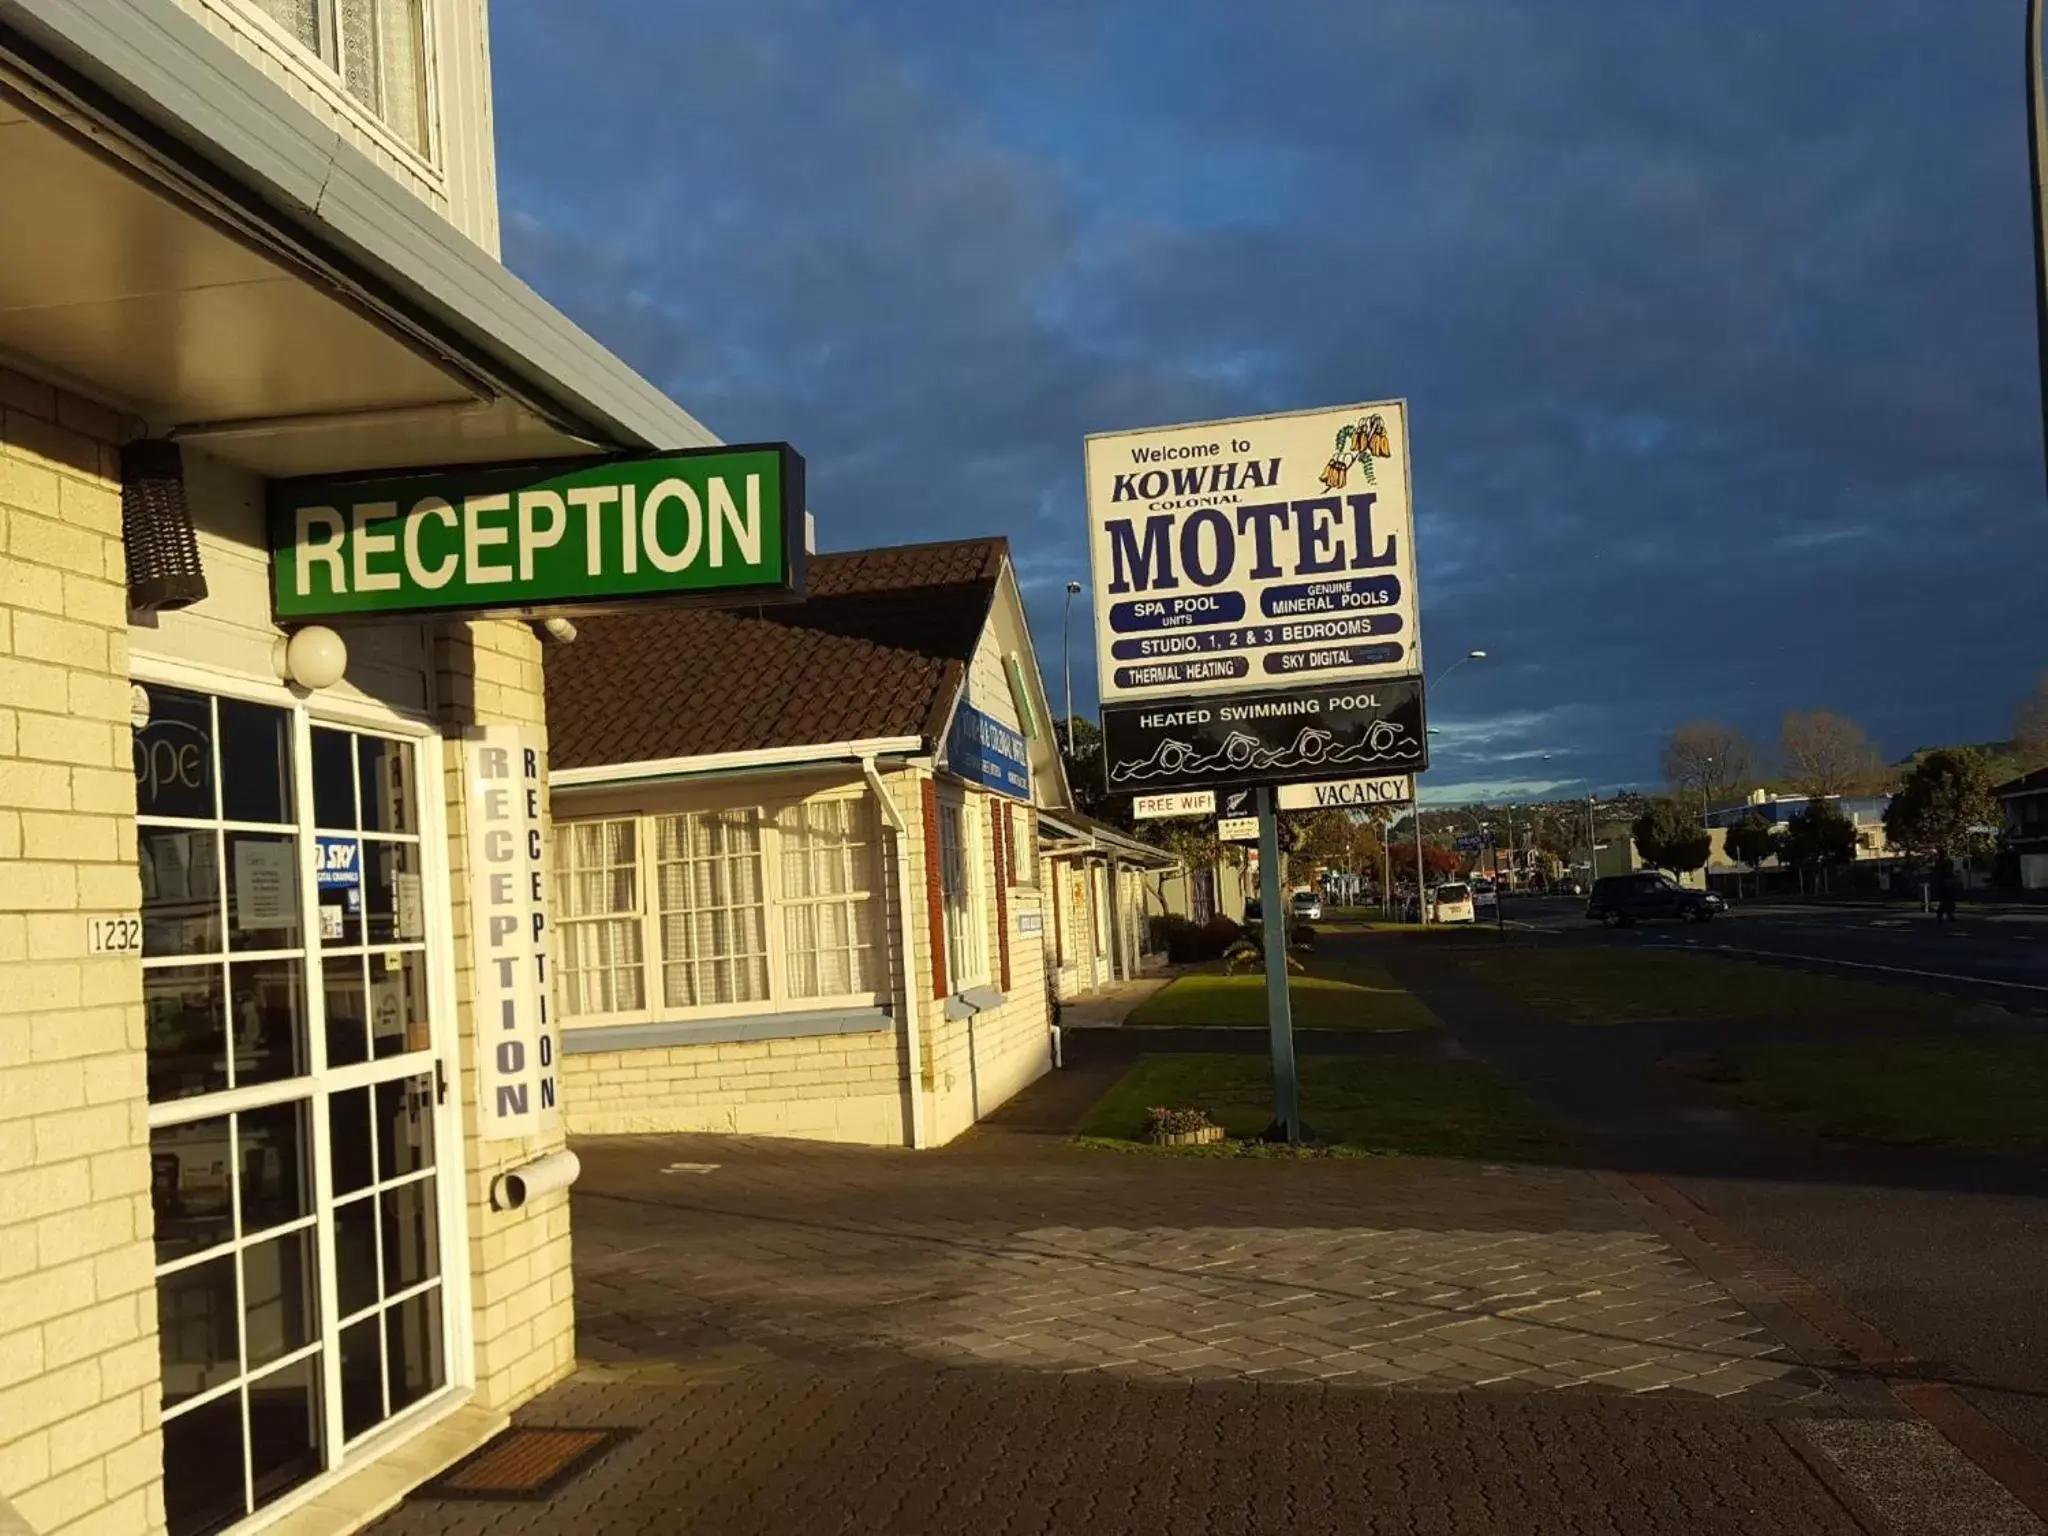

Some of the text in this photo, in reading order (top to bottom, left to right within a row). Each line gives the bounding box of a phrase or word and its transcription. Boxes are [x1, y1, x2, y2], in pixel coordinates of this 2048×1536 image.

[1132, 438, 1251, 464] Welcome to
[1111, 457, 1283, 503] KOWHAI
[1148, 494, 1242, 511] COLONIAL
[295, 473, 762, 596] RECEPTION
[1104, 493, 1398, 595] MOTEL
[1307, 582, 1353, 596] GENUINE
[1134, 597, 1220, 618] SPA POOL
[1272, 590, 1389, 616] MINERAL POOLS
[1162, 614, 1193, 627] UNITS
[1141, 619, 1372, 655] STUDIO, 1, 2 & 3 BEDROOMS
[1282, 653, 1305, 670] SKY
[1309, 648, 1354, 666] DIGITAL
[1129, 659, 1235, 686] THERMAL HEATING
[1140, 694, 1382, 728] HEATED SWIMMING POOL
[1138, 796, 1173, 813] FREE
[1314, 780, 1405, 806] VACANCY
[95, 920, 139, 950] 1232
[479, 747, 529, 1118] RECEPTION
[523, 747, 555, 1110] RECEPTION
